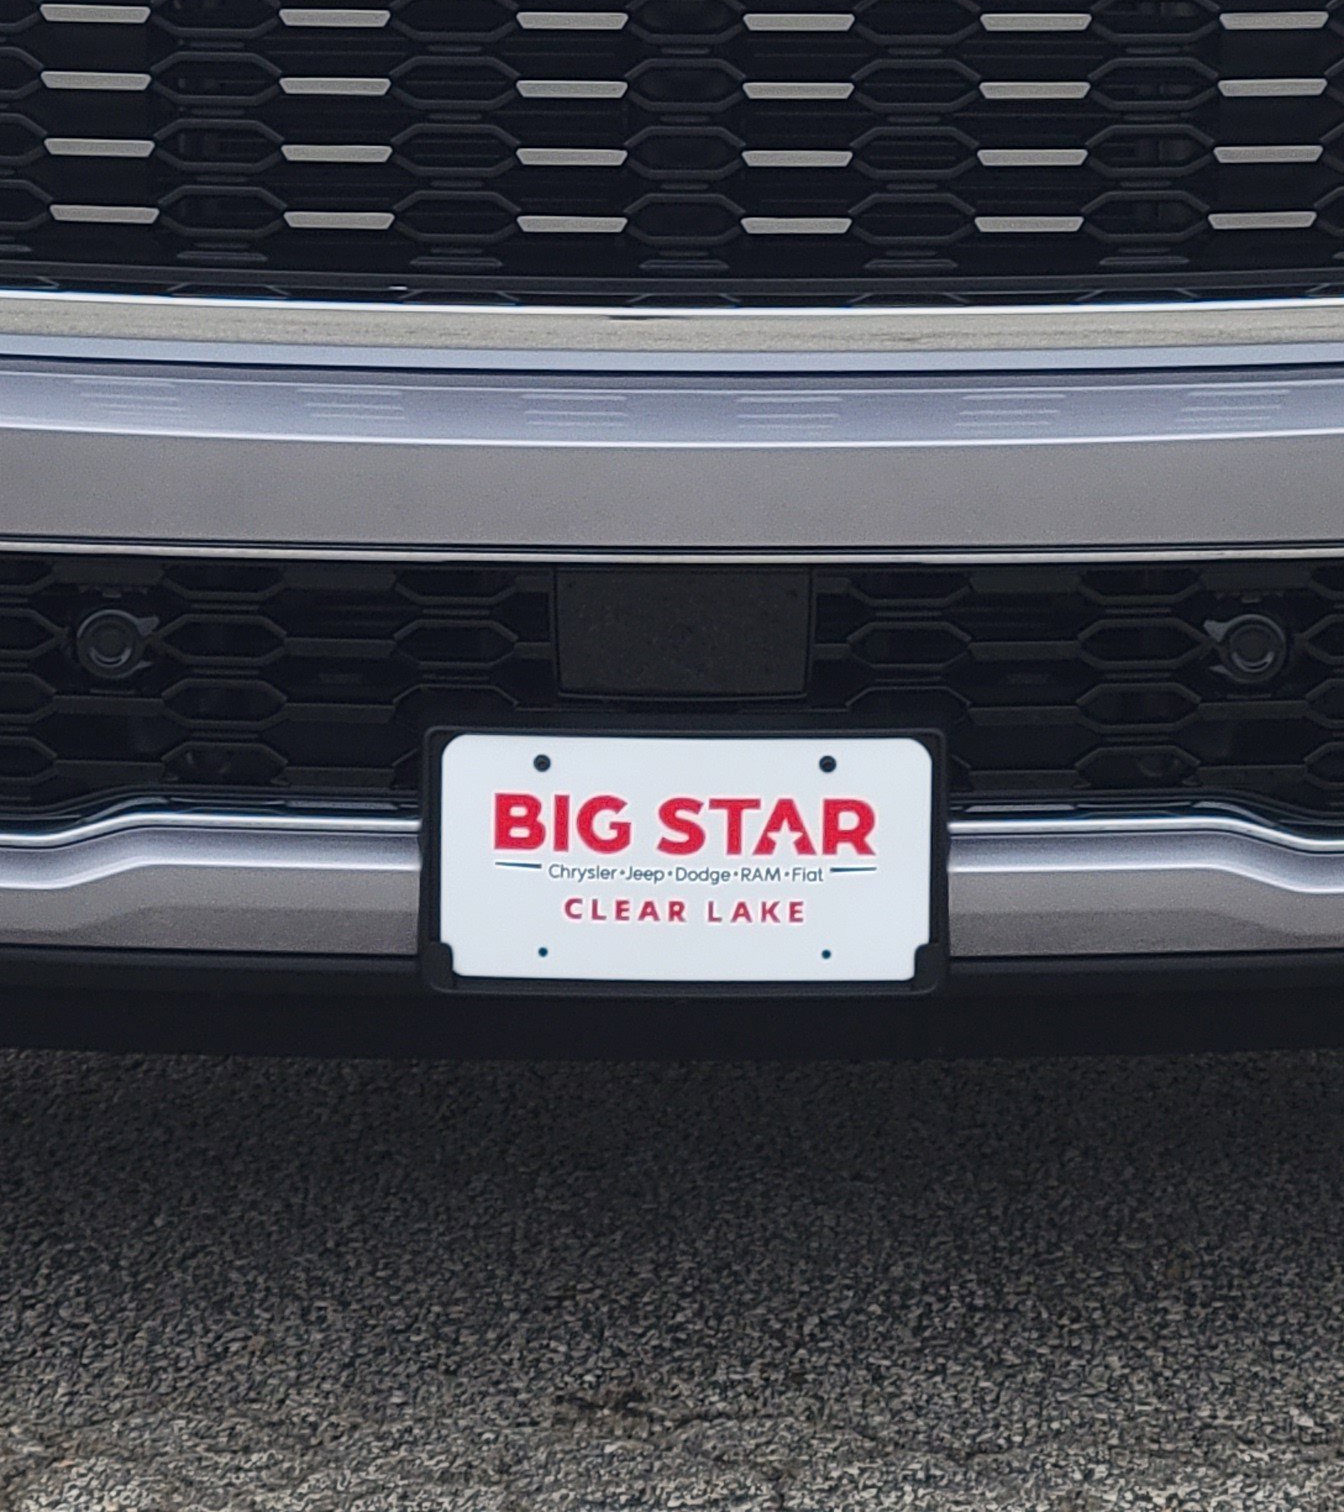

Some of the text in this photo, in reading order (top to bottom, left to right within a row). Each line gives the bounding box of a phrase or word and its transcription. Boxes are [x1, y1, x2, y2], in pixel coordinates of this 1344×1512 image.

[493, 792, 876, 856] BIG STAR
[564, 897, 804, 923] CLEAR LAKE
